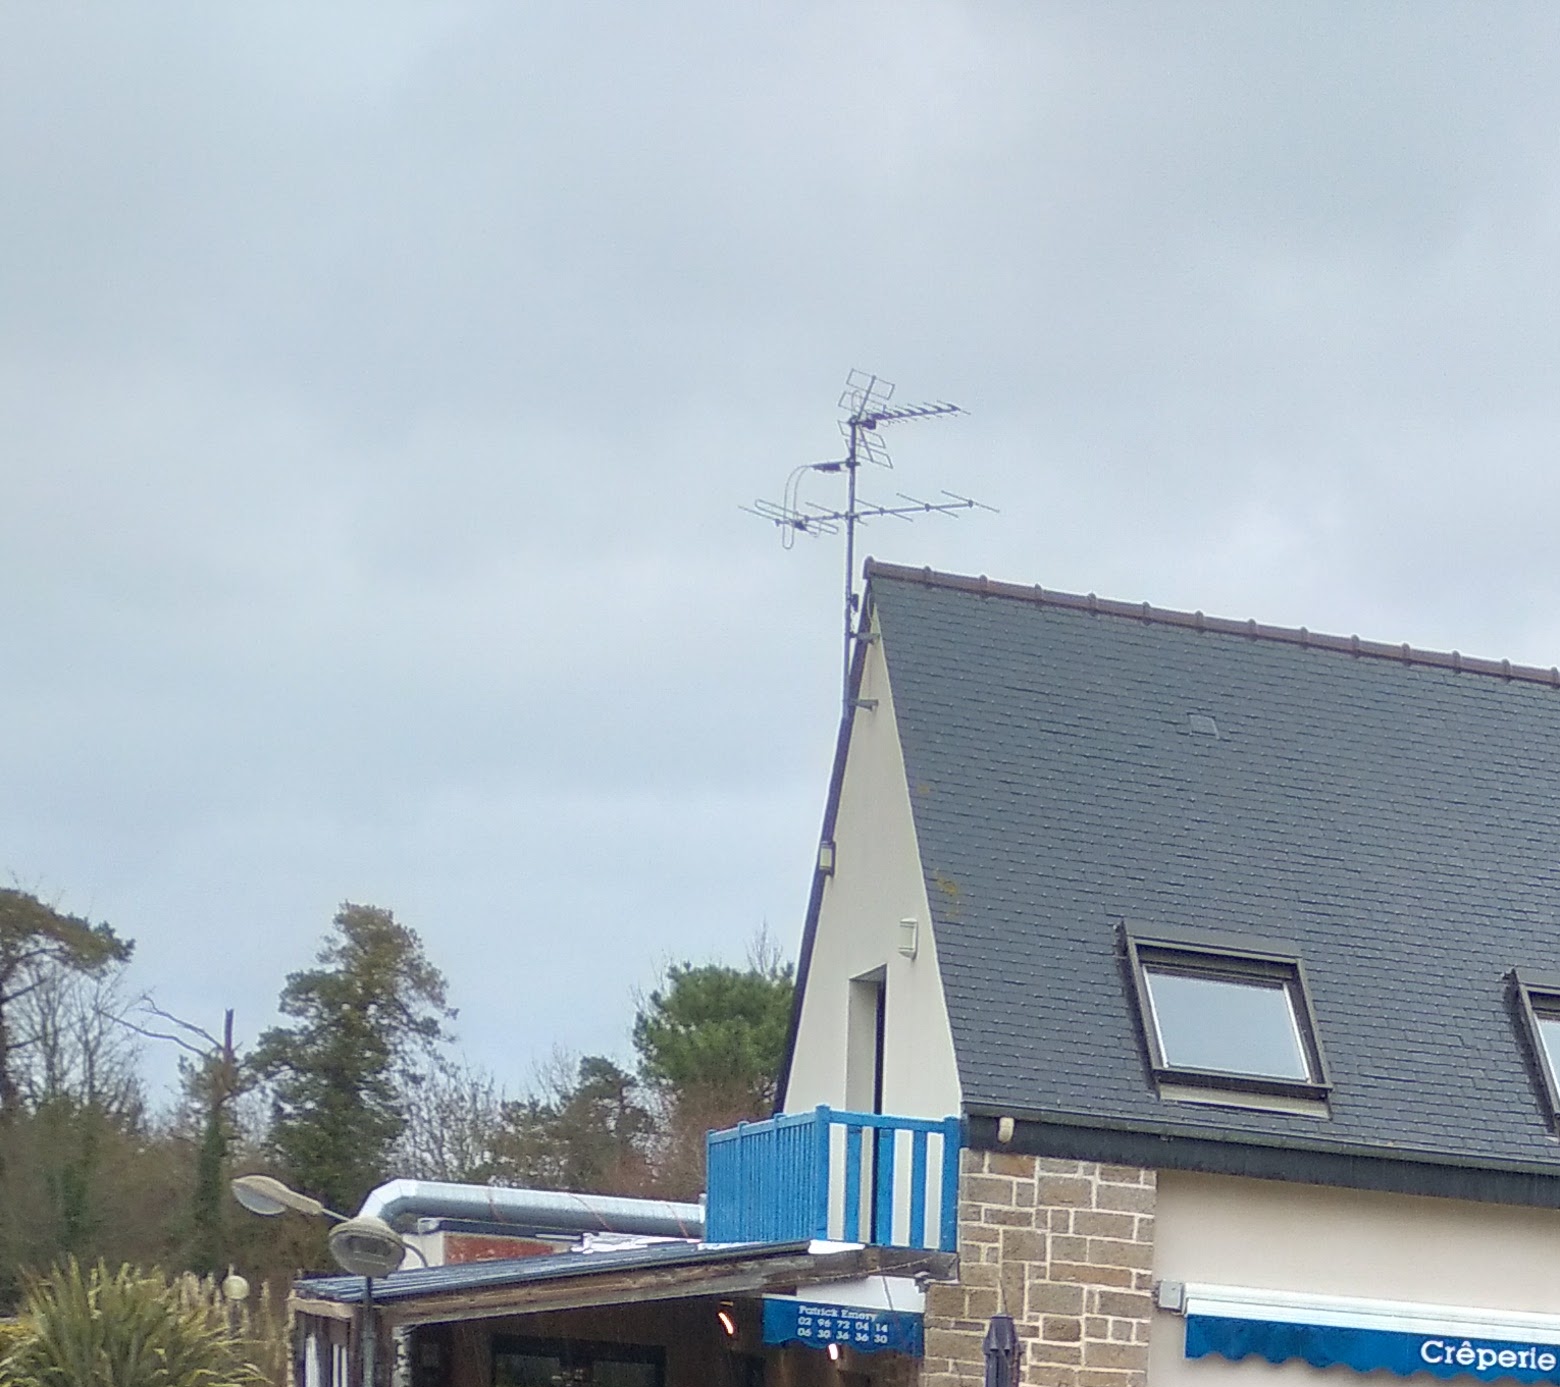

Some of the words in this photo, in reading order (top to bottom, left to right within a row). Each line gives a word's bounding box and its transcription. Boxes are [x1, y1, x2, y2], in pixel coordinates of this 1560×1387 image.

[798, 1305, 838, 1318] Patrick
[798, 1316, 812, 1326] 02
[817, 1318, 831, 1328] 96
[836, 1320, 851, 1330] 72
[855, 1321, 869, 1331] 04
[875, 1323, 888, 1333] 14
[874, 1334, 888, 1344] 30
[1420, 1340, 1557, 1371] Crêperie
